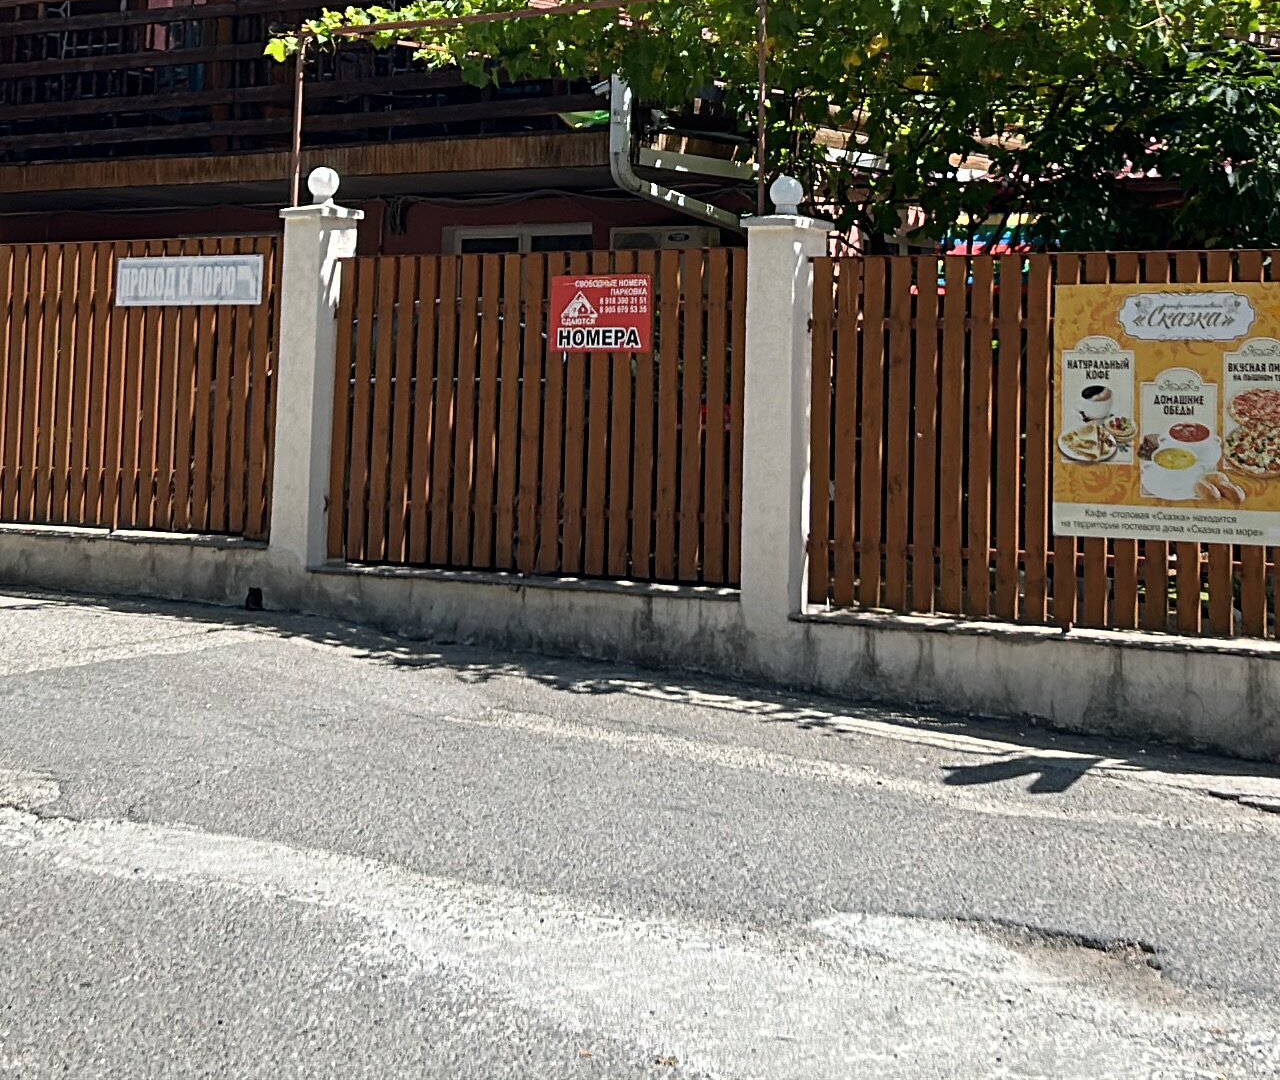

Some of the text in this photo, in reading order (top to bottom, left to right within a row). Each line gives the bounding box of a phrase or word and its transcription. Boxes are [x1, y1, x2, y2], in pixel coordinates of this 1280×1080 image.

[122, 265, 237, 300] ПРОХОД К МОРЮ
[618, 279, 648, 287] НОМЕРА
[610, 288, 648, 296] ПАРКОВКА
[1133, 303, 1235, 330] «Сказка»
[558, 328, 640, 348] НОМЕРА
[1067, 358, 1130, 370] НАТУРАЛЬНЫЙ
[1228, 363, 1266, 373] ВКУСНАЯ
[1086, 370, 1110, 380] КОФЕ
[1154, 395, 1204, 405] ДОМАШНИЕ
[1163, 406, 1194, 415] ОБЕДЫ
[1085, 508, 1107, 518] Кафе
